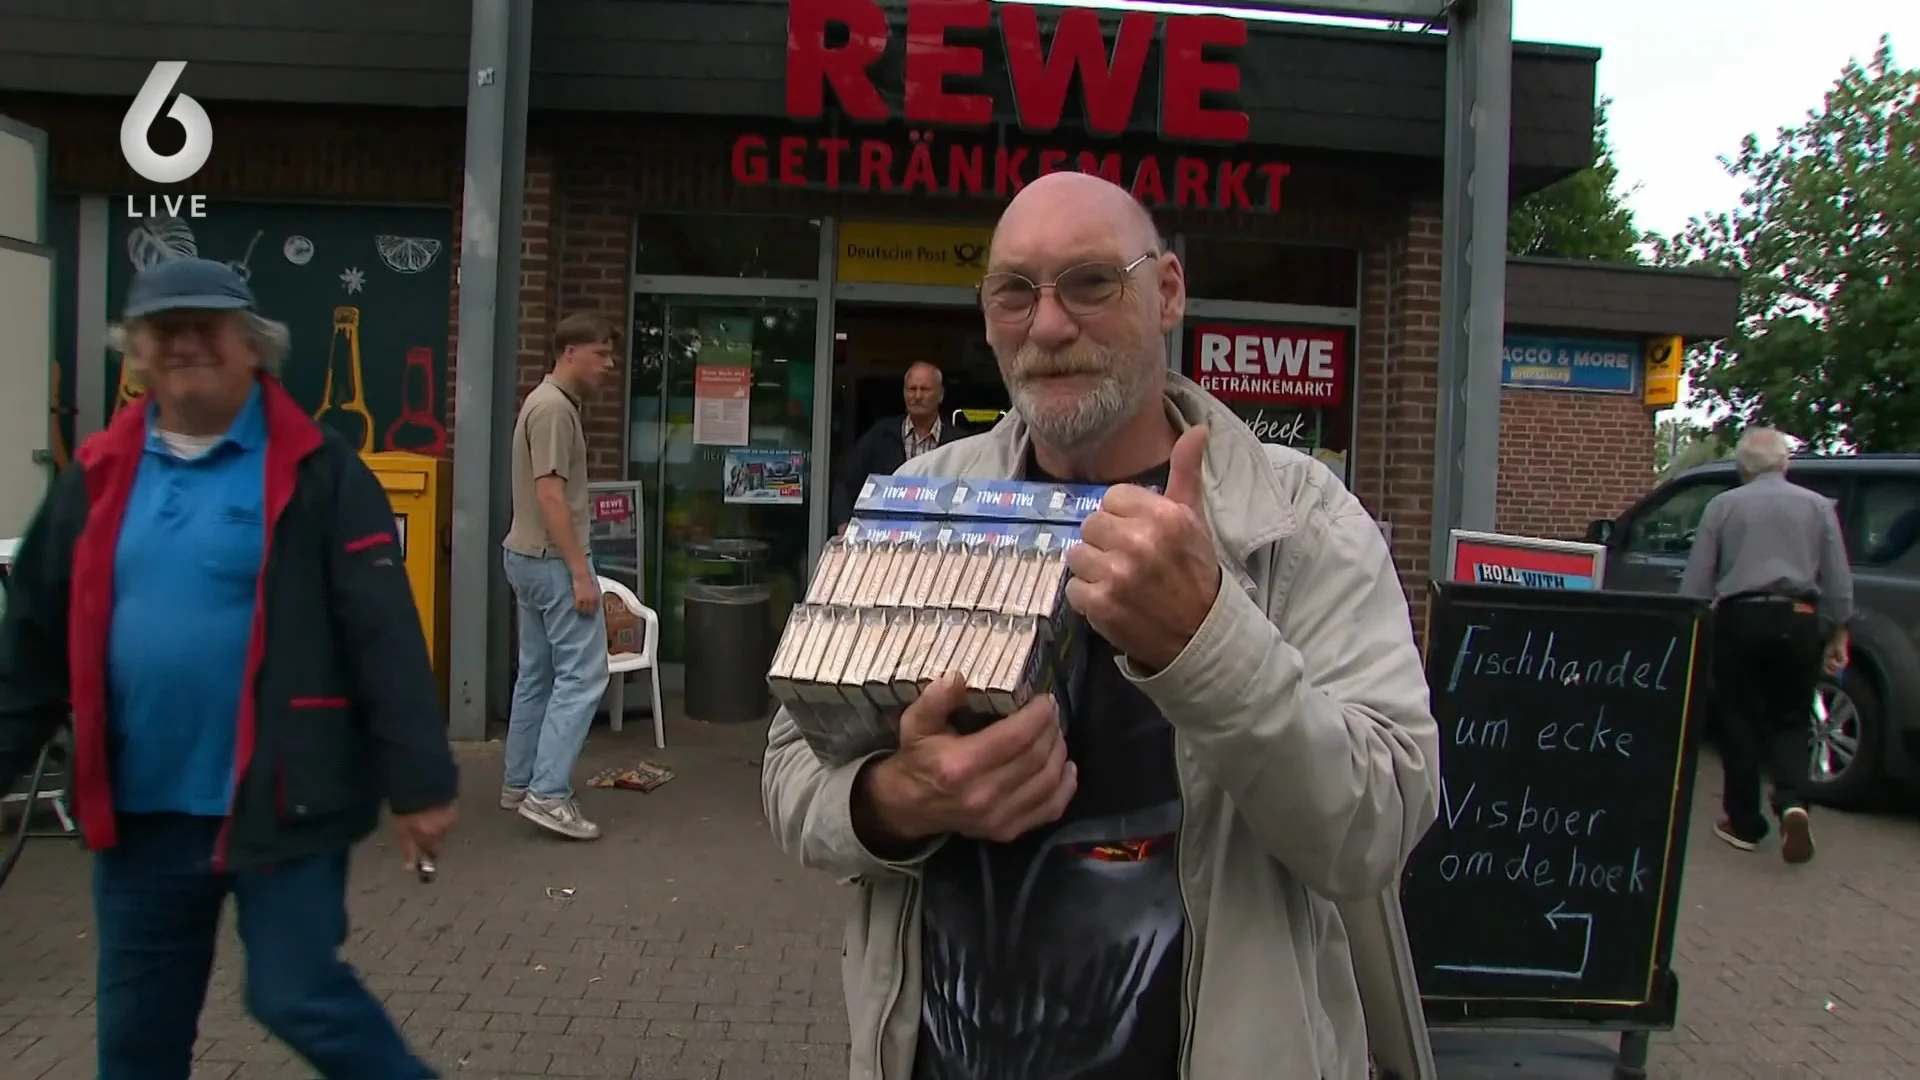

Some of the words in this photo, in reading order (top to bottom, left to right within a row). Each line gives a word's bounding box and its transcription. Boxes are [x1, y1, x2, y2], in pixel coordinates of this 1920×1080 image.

[786, 0, 1249, 139] REWE
[847, 243, 913, 261] Deutsche
[917, 246, 948, 262] Post
[1200, 333, 1335, 378] REWE
[1557, 348, 1570, 366] &
[1574, 351, 1629, 369] MORE
[1200, 374, 1335, 397] GETRÄNKEMARKT
[976, 490, 1003, 506] MALL
[1010, 491, 1036, 507] PALL
[1482, 563, 1522, 582] ROLL
[1522, 571, 1565, 589] WITH
[1447, 624, 1677, 692] Fischhandel
[1455, 716, 1509, 749] um
[1537, 704, 1634, 757] ecke
[1441, 776, 1606, 836] Visboer
[1439, 850, 1493, 882] om
[1504, 842, 1556, 887] de
[1568, 846, 1649, 893] hoek
